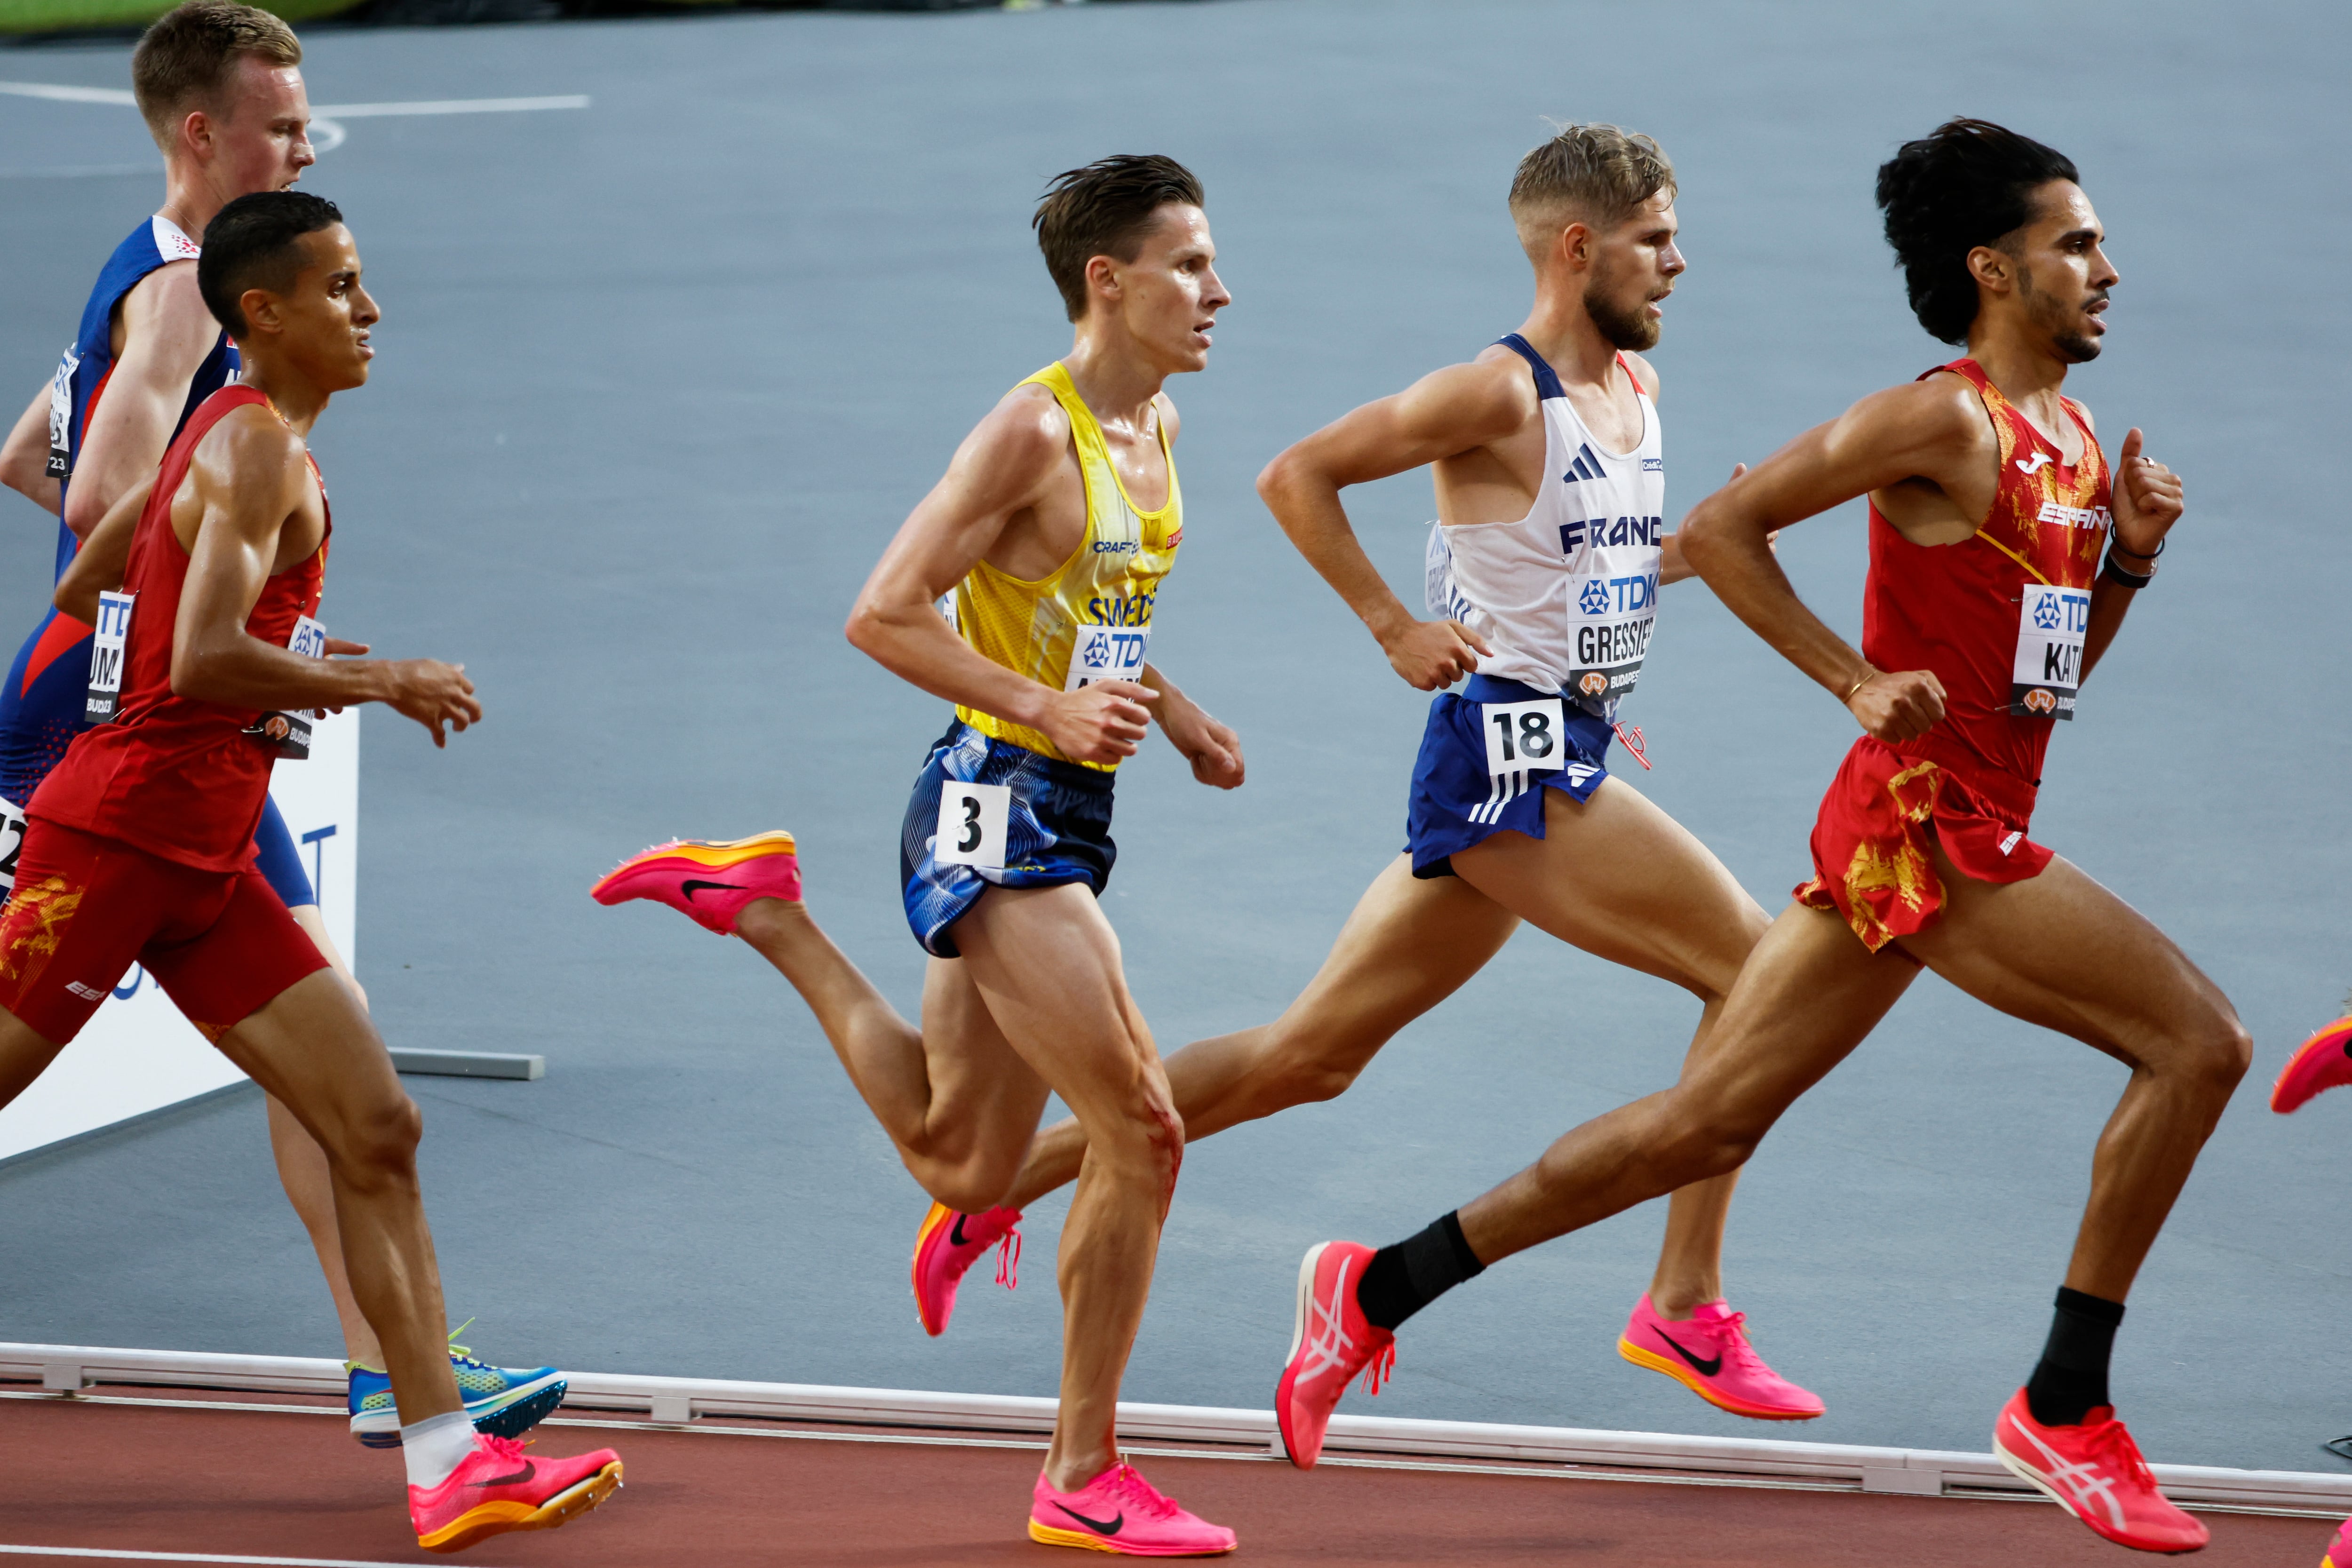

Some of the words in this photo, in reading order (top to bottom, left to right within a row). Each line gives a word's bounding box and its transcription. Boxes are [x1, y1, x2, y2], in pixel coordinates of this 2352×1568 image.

[1093, 541, 1132, 554] CRAFT
[1559, 517, 1661, 554] FRANC
[1610, 572, 1659, 613] TDK
[1578, 617, 1653, 664] GRESSIER
[1493, 712, 1553, 761] 18
[958, 796, 982, 853] 3
